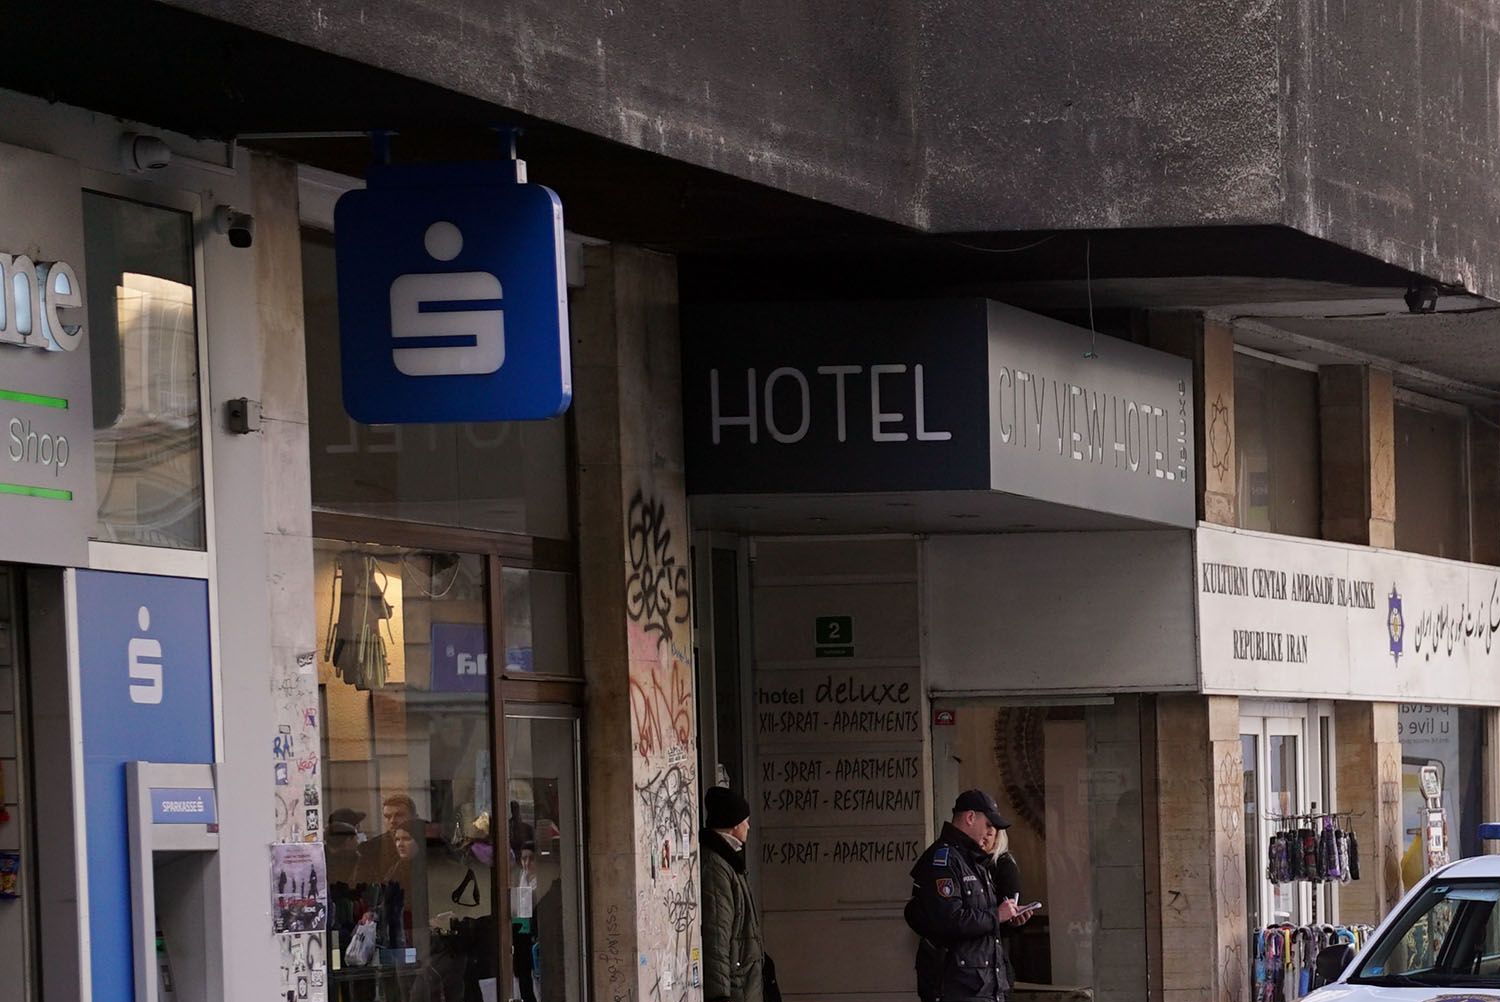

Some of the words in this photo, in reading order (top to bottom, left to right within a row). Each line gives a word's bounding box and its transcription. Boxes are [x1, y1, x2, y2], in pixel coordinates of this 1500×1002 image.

[711, 364, 952, 444] HOTEL
[1000, 366, 1045, 450] CITY
[1054, 380, 1106, 465] VIEW
[1113, 395, 1176, 480] HOTEL
[9, 417, 70, 477] Shop
[1202, 562, 1249, 597] KULTURNI
[1252, 568, 1288, 601] CENTAR
[1291, 572, 1335, 606] AMBASADE
[1337, 577, 1376, 610] ISLAMSKE
[828, 622, 841, 639] 2
[1233, 629, 1284, 663] REPUBLIKE
[1286, 633, 1309, 664] IRAN
[759, 687, 804, 704] hotel
[815, 676, 910, 705] deluxe
[833, 710, 919, 733] APARTMENTS
[835, 756, 918, 781] APARTMENTS
[834, 789, 921, 811] RESTAURANT
[833, 840, 919, 864] APARTMENTS
